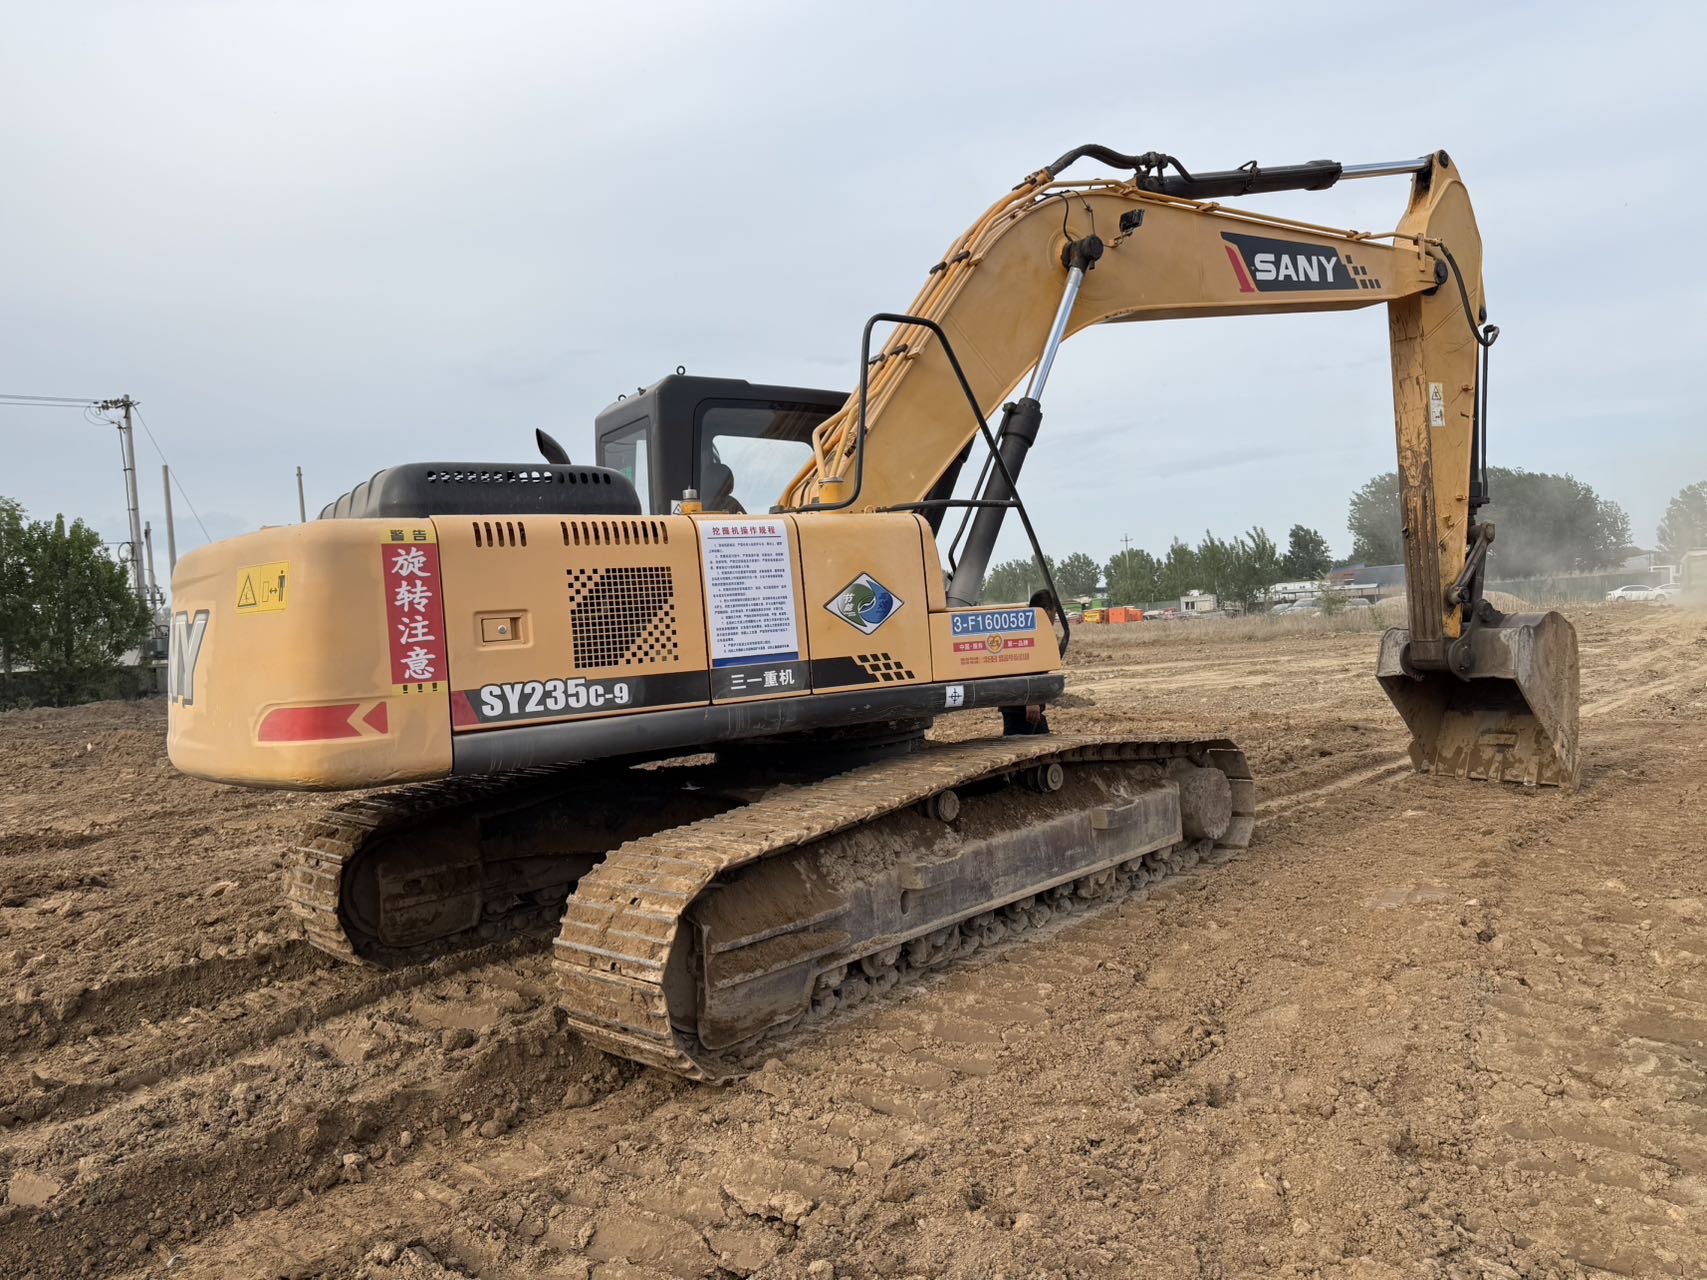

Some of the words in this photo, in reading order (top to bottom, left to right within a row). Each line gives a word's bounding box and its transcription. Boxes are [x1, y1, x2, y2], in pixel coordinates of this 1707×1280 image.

[1254, 253, 1338, 282] SANY
[390, 529, 427, 542] 警告
[711, 526, 777, 536] 挖掘机操作规程
[391, 546, 436, 681] 旋转注意
[953, 611, 1033, 632] 3-F1600587
[731, 669, 795, 690] 三一重机
